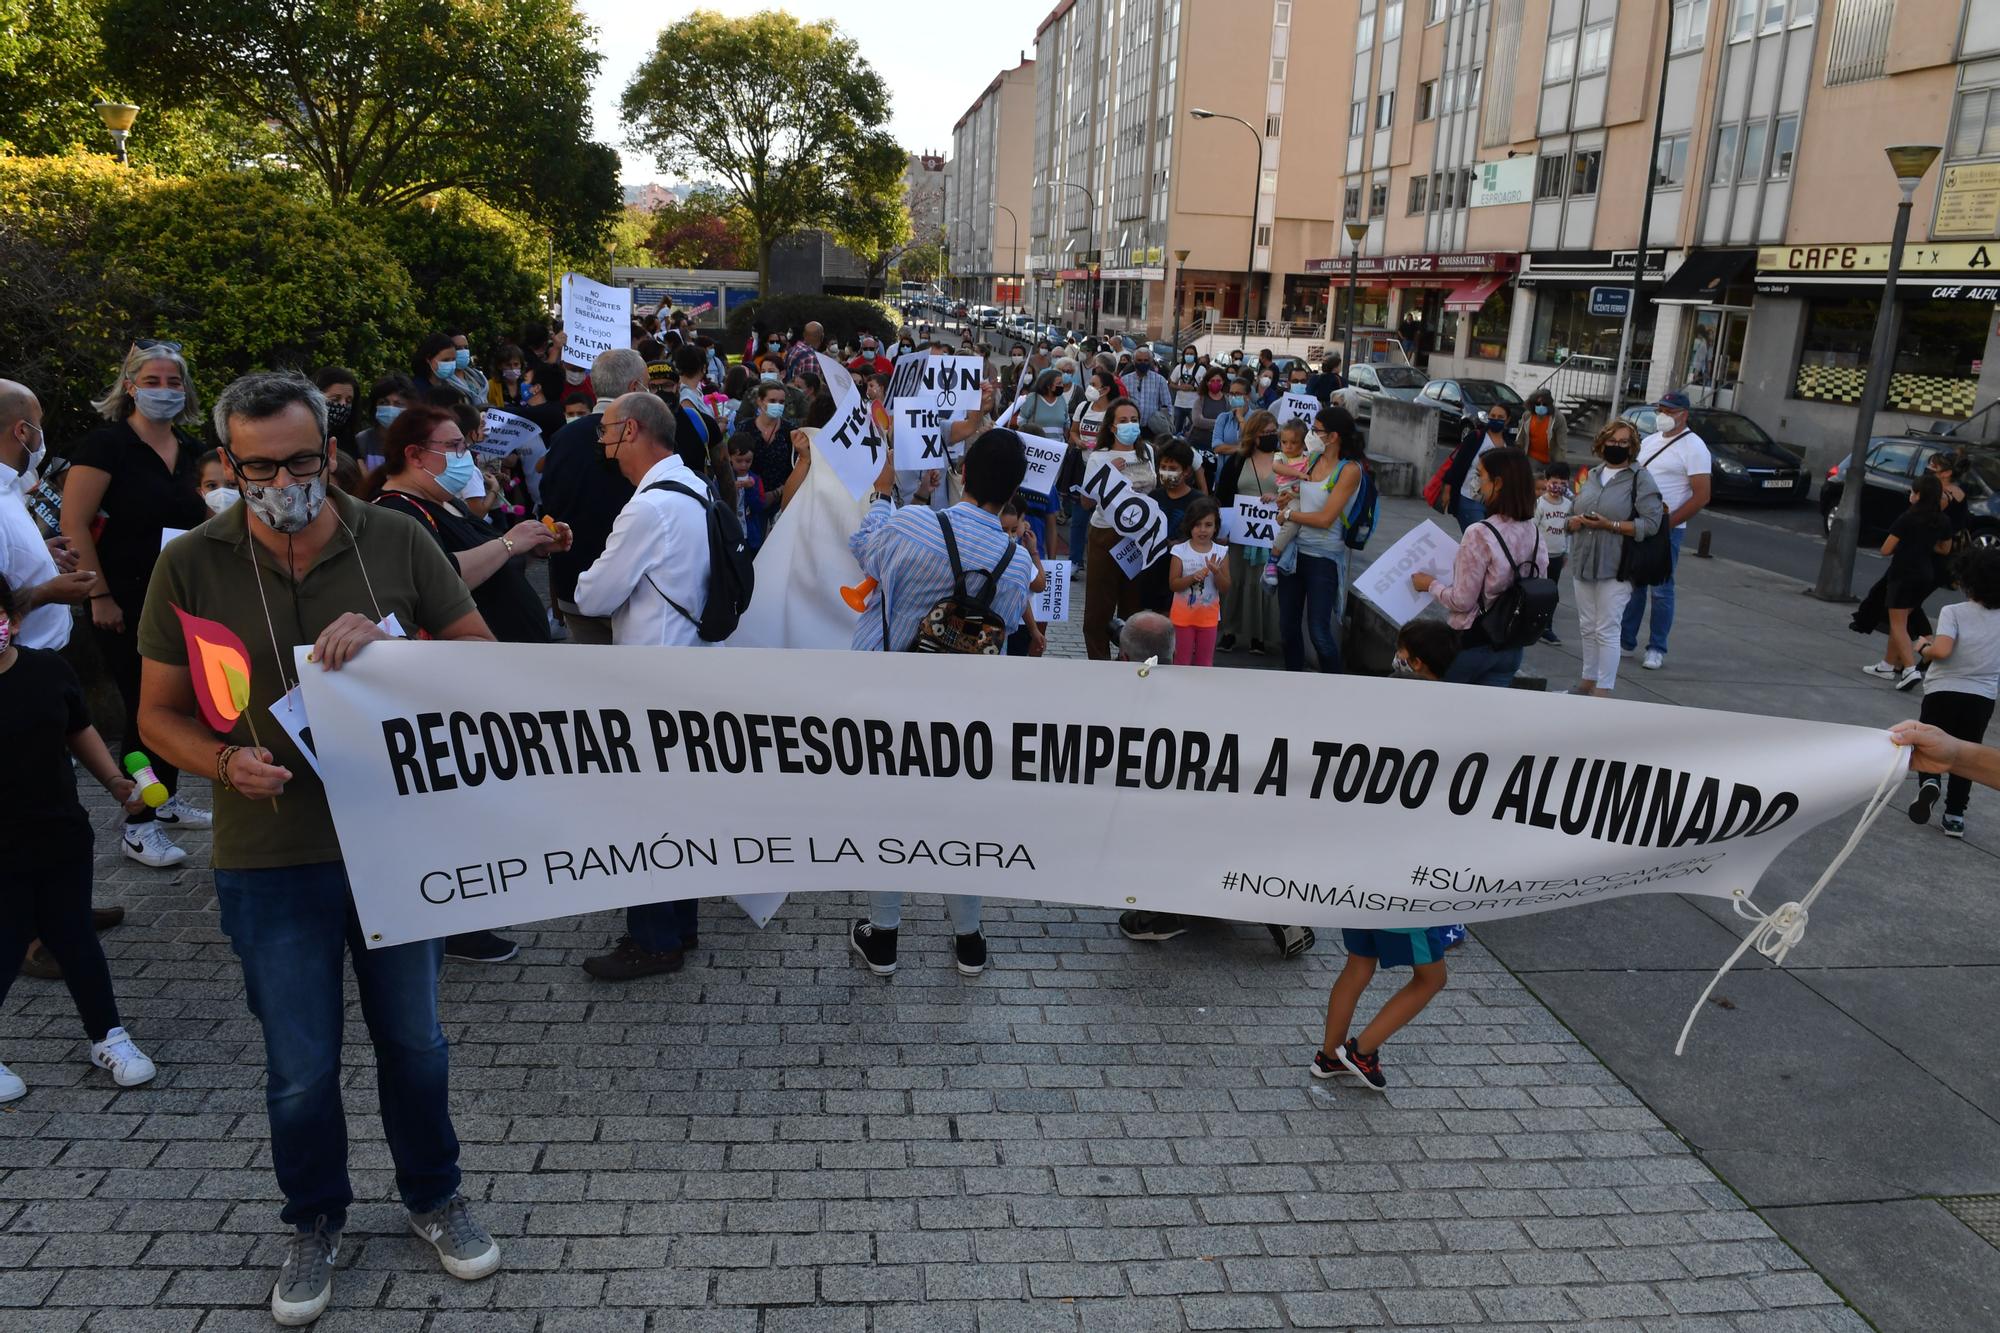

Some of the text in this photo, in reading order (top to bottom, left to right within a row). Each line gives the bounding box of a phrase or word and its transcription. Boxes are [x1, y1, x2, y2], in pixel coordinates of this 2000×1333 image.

[1480, 190, 1522, 205] ESPROAGRO
[1438, 255, 1486, 267] CROISSANTERIA
[1788, 247, 1858, 269] CAFE
[590, 289, 600, 299] NO
[1931, 285, 1998, 300] CAFÉ ALFIL
[584, 296, 621, 311] RECORTES
[1593, 303, 1626, 313] VICENTE FERRER
[575, 307, 615, 323] ENSEÑANZA
[574, 334, 612, 351] FALTAN
[487, 412, 505, 423] SEN
[921, 434, 944, 459] X
[1084, 463, 1169, 565] NON
[1244, 521, 1275, 541] XA
[1042, 571, 1052, 612] MESTRE
[1053, 562, 1063, 620] QUEREMOS
[381, 709, 1799, 848] RECORTAR PROFESORADO EMPEORA A TODO O ALUMNADO
[420, 832, 1036, 904] CEIP RAMÓN DE LA SAGRA
